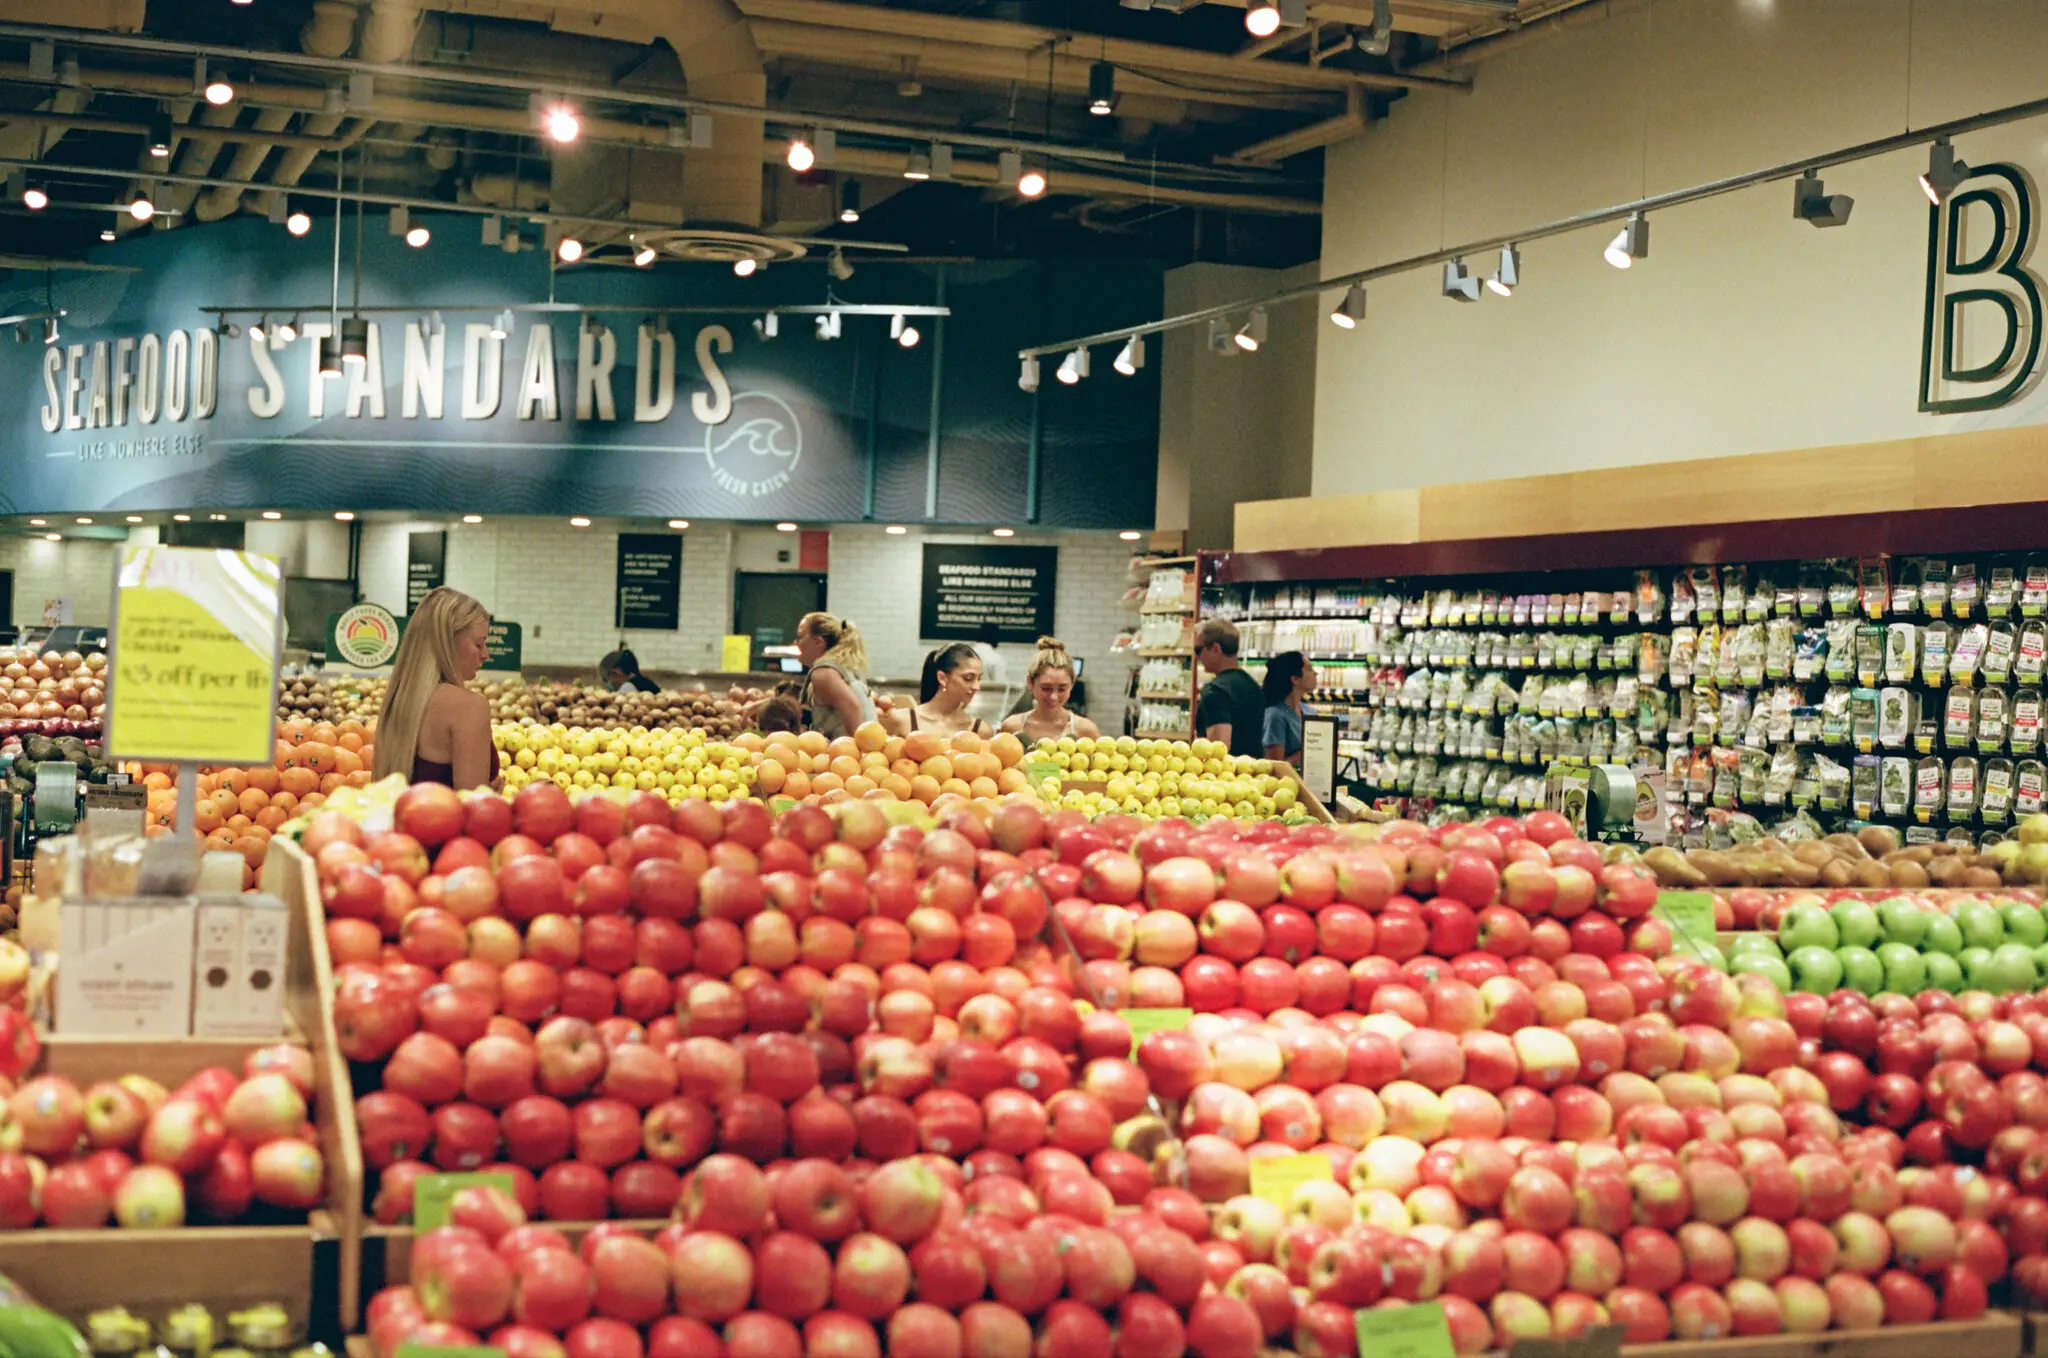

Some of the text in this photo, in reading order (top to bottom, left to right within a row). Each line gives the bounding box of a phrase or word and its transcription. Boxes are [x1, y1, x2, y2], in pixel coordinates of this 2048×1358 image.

[41, 322, 734, 433] SEAFOOD STANDARDS
[79, 433, 204, 461] LIKE NOWHERE ELSE
[712, 467, 790, 498] FRESH CATCH
[156, 663, 198, 686] off
